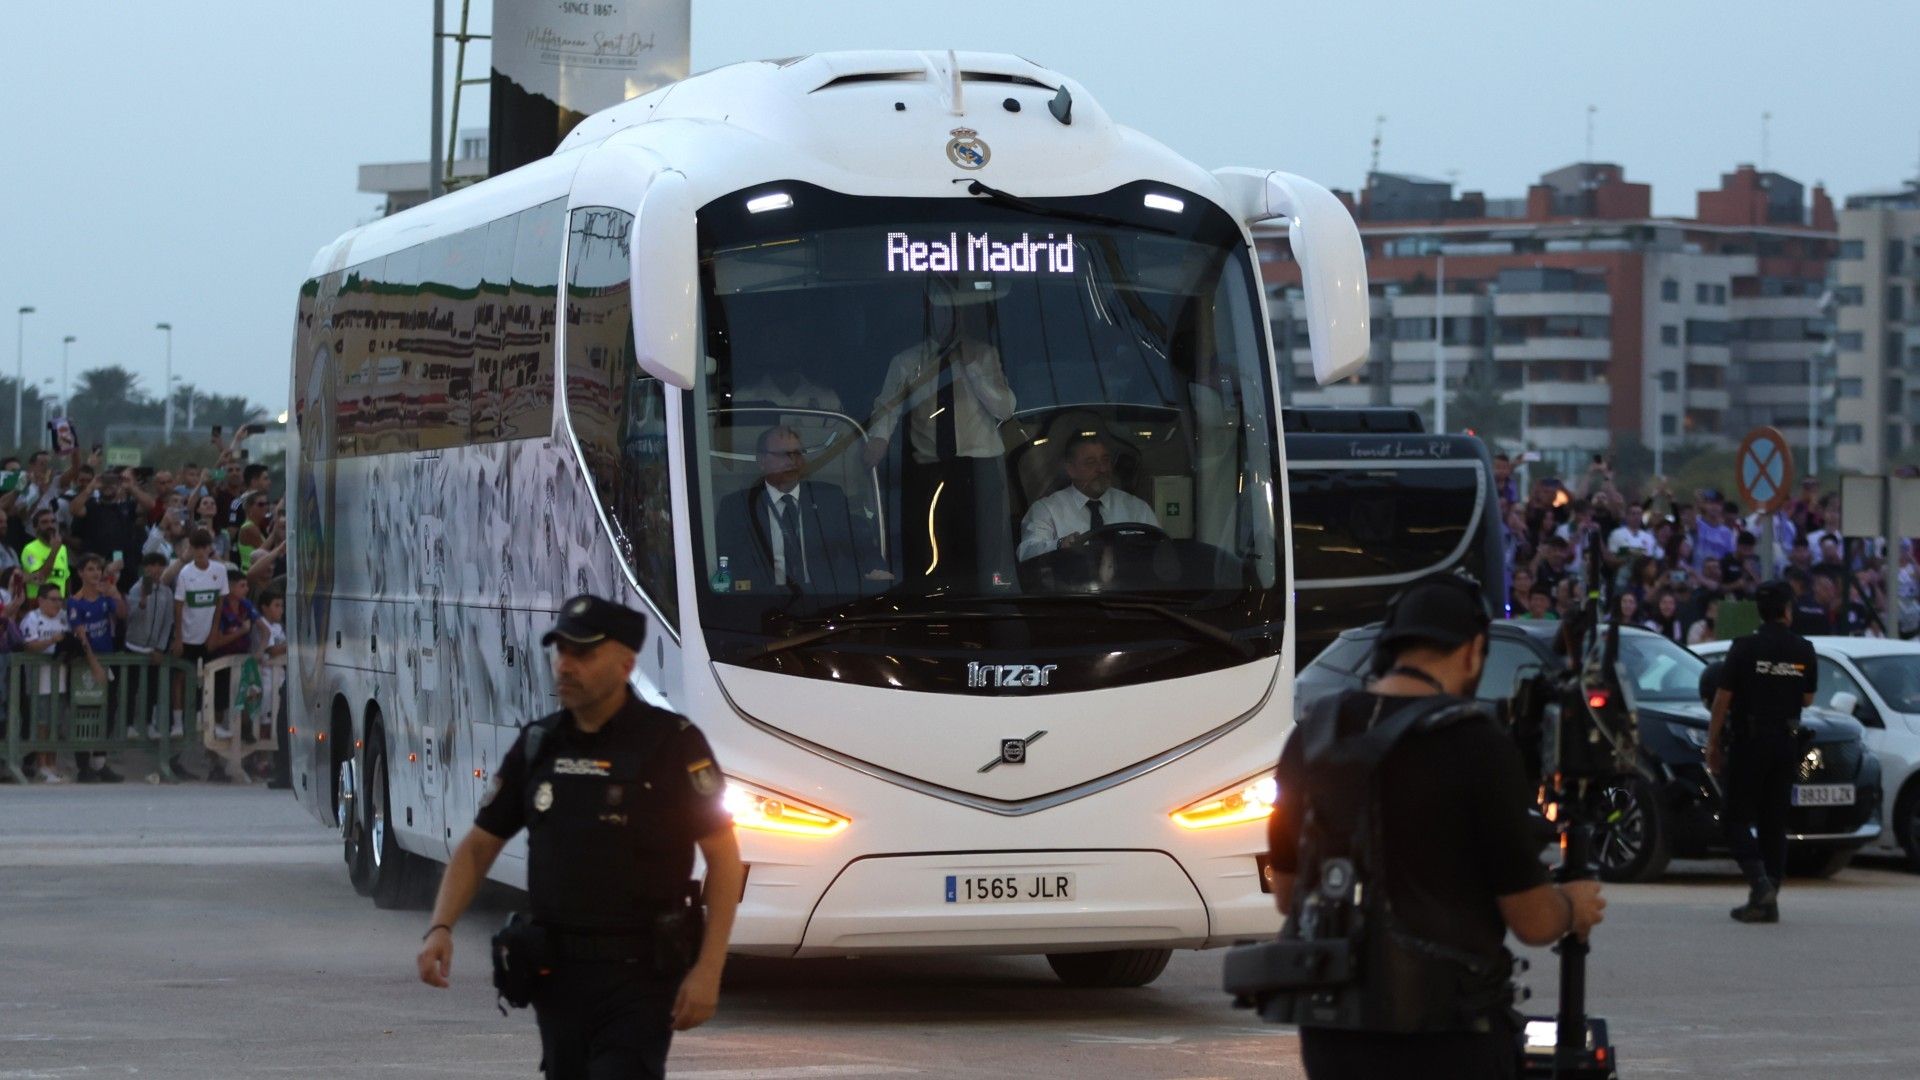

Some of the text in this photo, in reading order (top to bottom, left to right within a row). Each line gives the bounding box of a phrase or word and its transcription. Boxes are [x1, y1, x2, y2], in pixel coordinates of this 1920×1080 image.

[563, 2, 589, 16] SINCE
[887, 232, 1074, 273] Real Madrid
[965, 878, 1018, 900] 1565
[1028, 876, 1069, 898] JLR
